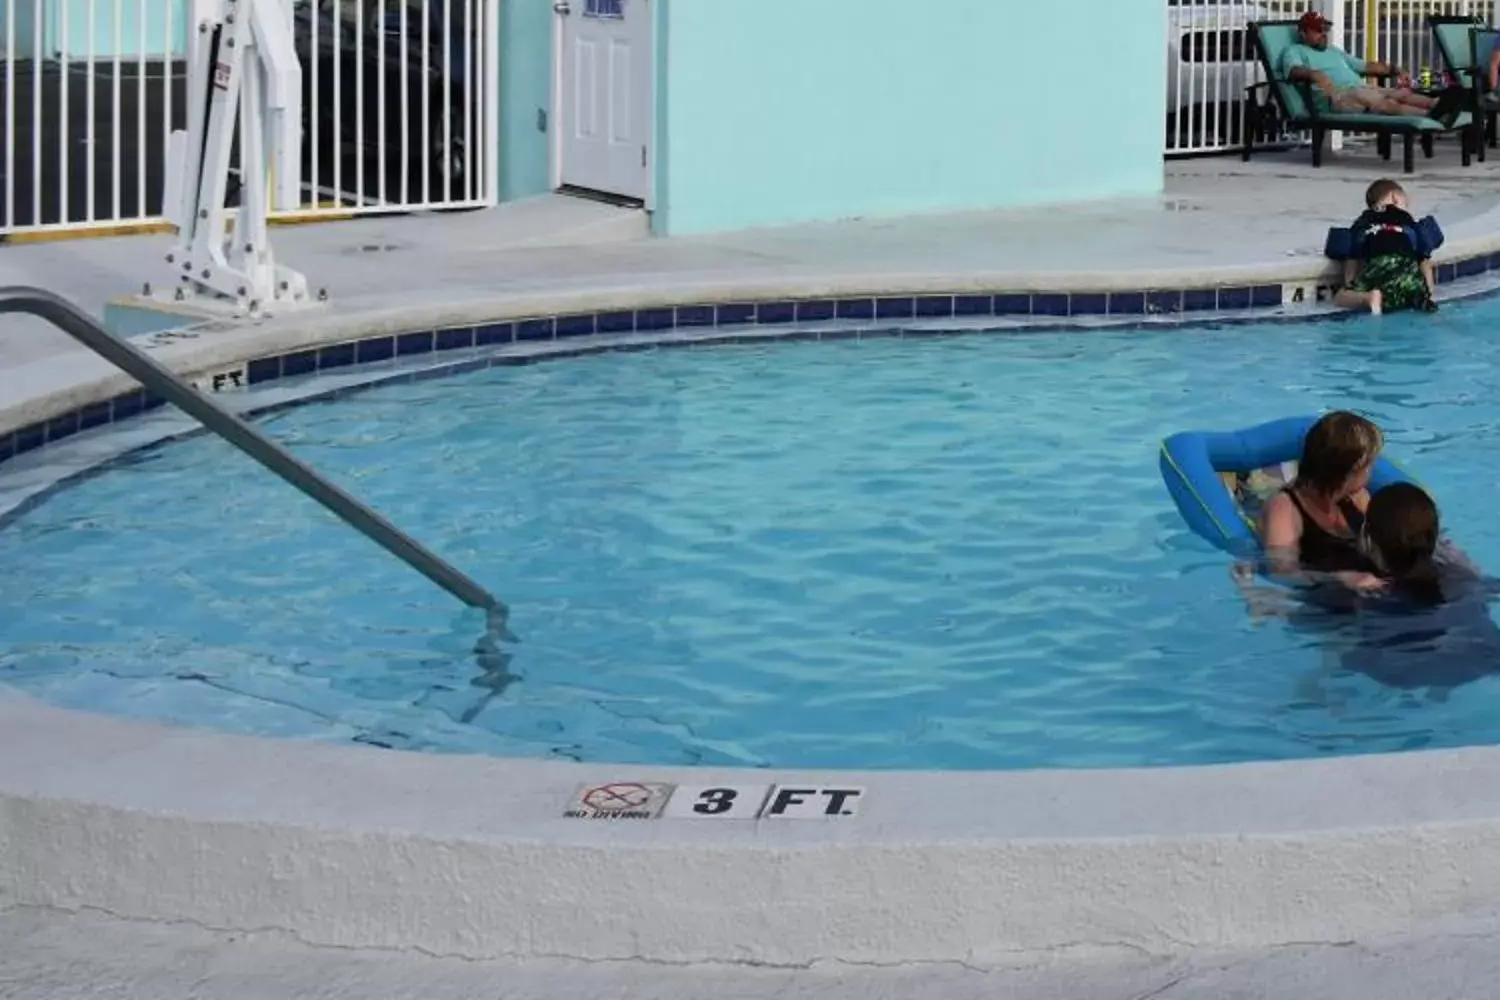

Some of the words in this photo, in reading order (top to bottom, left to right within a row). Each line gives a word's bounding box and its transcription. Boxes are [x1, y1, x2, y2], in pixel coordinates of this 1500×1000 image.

[212, 369, 243, 392] FT
[693, 788, 737, 815] 3
[769, 788, 861, 815] FT.
